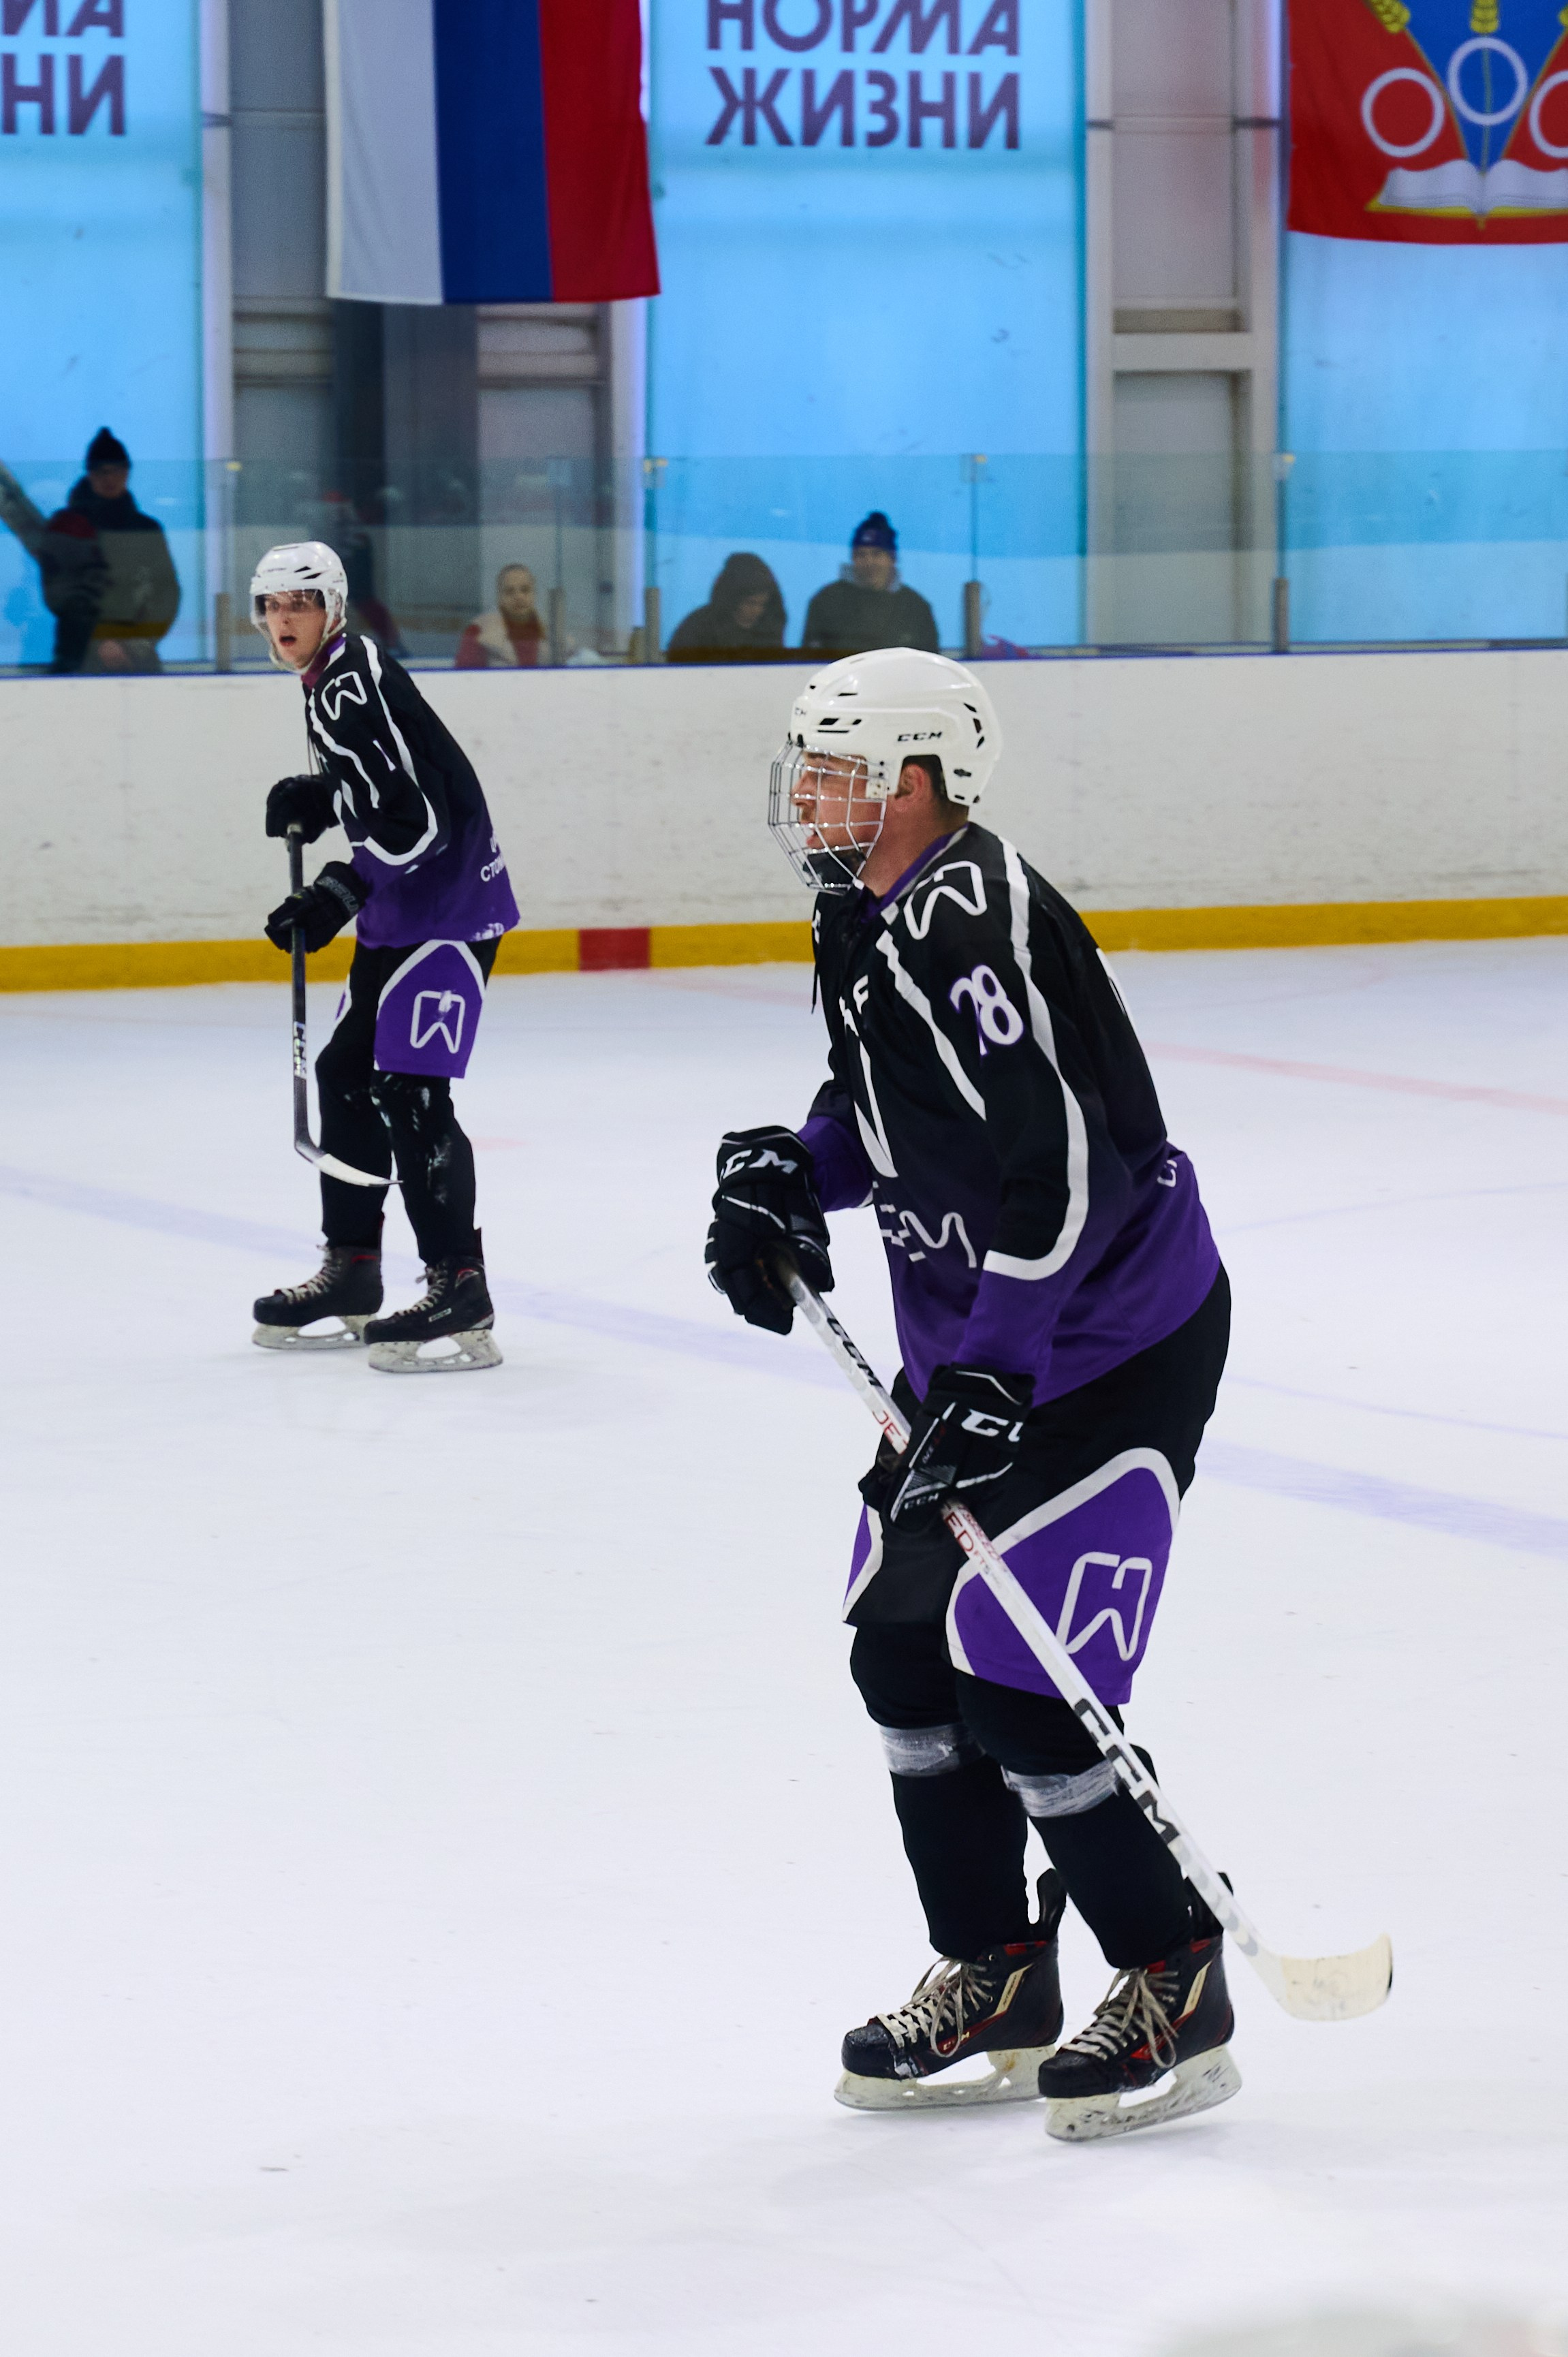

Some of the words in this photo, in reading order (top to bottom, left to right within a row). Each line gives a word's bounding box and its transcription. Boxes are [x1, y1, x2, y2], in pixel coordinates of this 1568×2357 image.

[706, 0, 1019, 57] НОРМА
[704, 65, 1020, 150] ЖИЗНИ
[897, 731, 942, 742] CCM
[719, 1149, 798, 1180] CM
[826, 1317, 883, 1388] CCM
[1074, 1698, 1180, 1845] CCM
